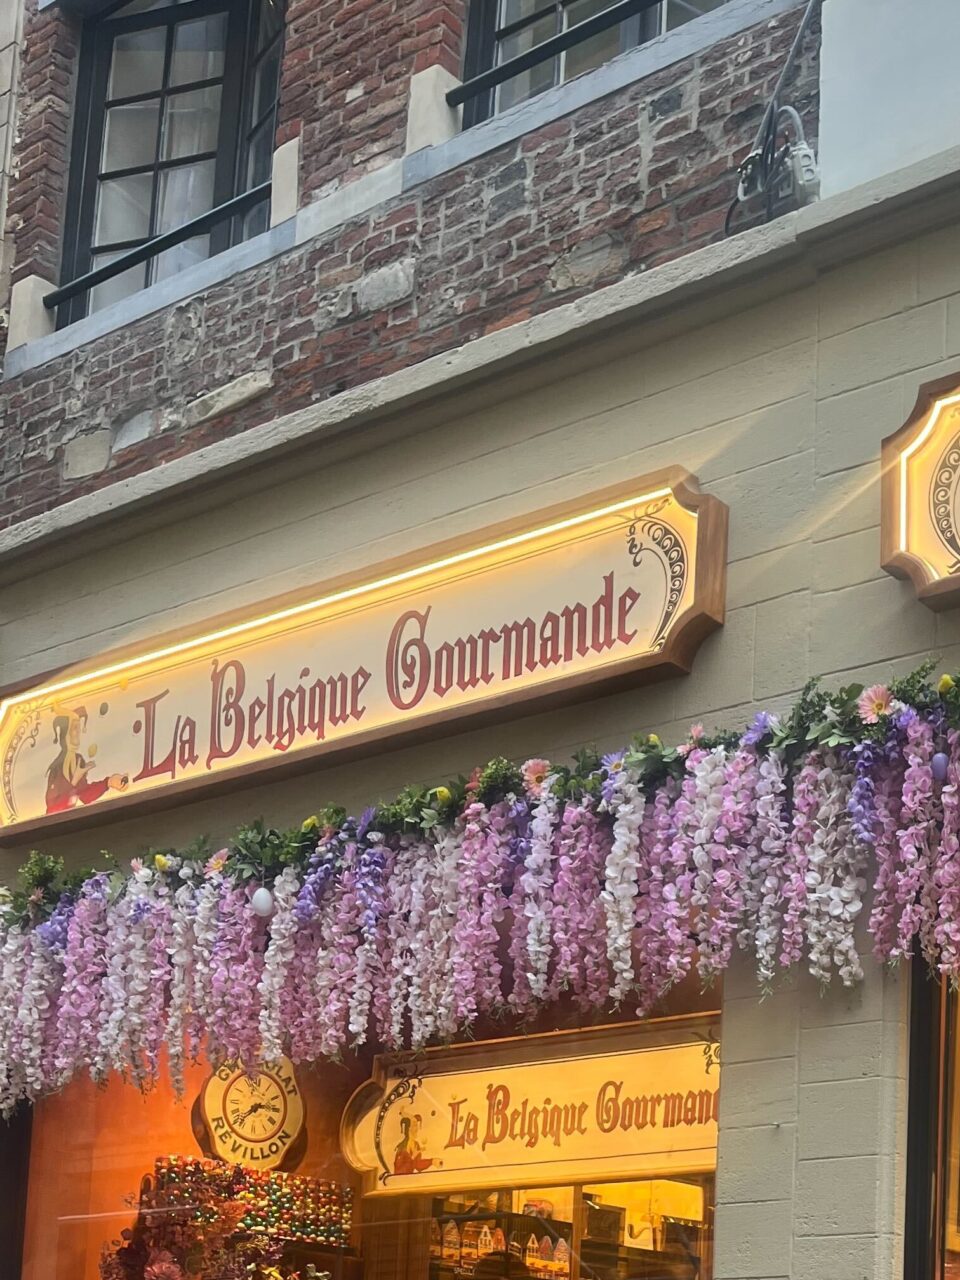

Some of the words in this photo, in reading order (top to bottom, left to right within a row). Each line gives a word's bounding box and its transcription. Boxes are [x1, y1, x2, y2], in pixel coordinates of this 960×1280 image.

[132, 688, 199, 784] La
[205, 658, 373, 769] Belgique
[385, 569, 642, 711] Gourmande
[444, 1098, 480, 1150] La
[481, 1083, 590, 1152] Belgique
